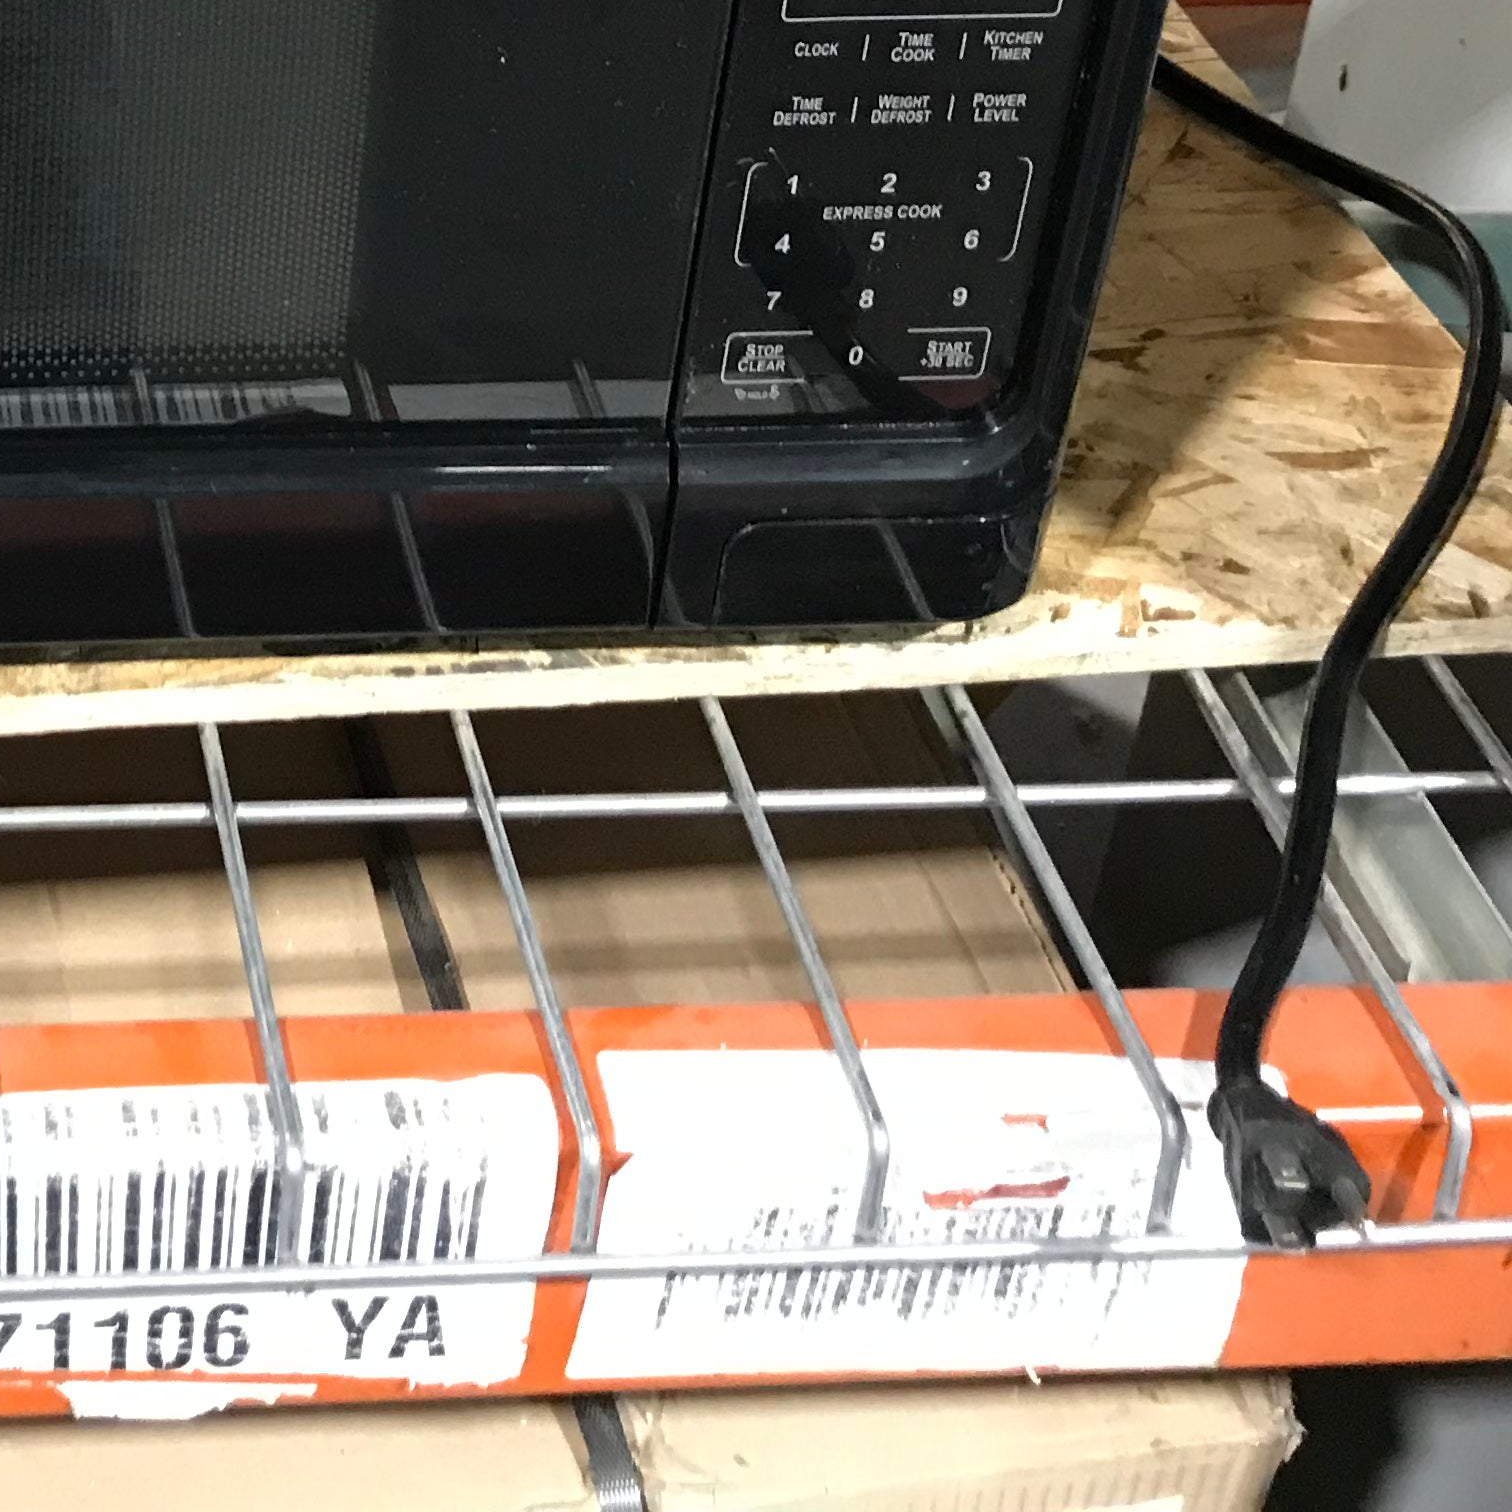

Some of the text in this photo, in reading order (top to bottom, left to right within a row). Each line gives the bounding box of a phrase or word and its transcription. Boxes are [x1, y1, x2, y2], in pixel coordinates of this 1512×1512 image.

[898, 31, 935, 47] TIME
[982, 29, 1044, 45] KITCHEN
[793, 41, 839, 57] CLOCK
[890, 47, 936, 62] COOK
[989, 45, 1032, 61] TIMER
[791, 95, 824, 111] TIME
[877, 94, 931, 109] WEIGHT
[972, 92, 1027, 108] POWER
[772, 110, 837, 127] DEFROST
[870, 109, 932, 125] DEFROST
[973, 108, 1020, 123] LEVEL
[786, 174, 799, 195] 1
[880, 173, 898, 194] 2
[975, 170, 992, 192] 3
[822, 203, 943, 222] EXPRESS COOK
[774, 233, 792, 255] 4
[869, 231, 886, 252] 5
[963, 228, 980, 250] 6
[766, 290, 783, 311] 7
[858, 288, 875, 309] 8
[952, 286, 968, 307] 9
[745, 343, 785, 357] STOP
[926, 339, 974, 355] START
[848, 345, 864, 366] 0
[737, 357, 787, 373] CLEAR
[331, 1293, 447, 1361] YA
